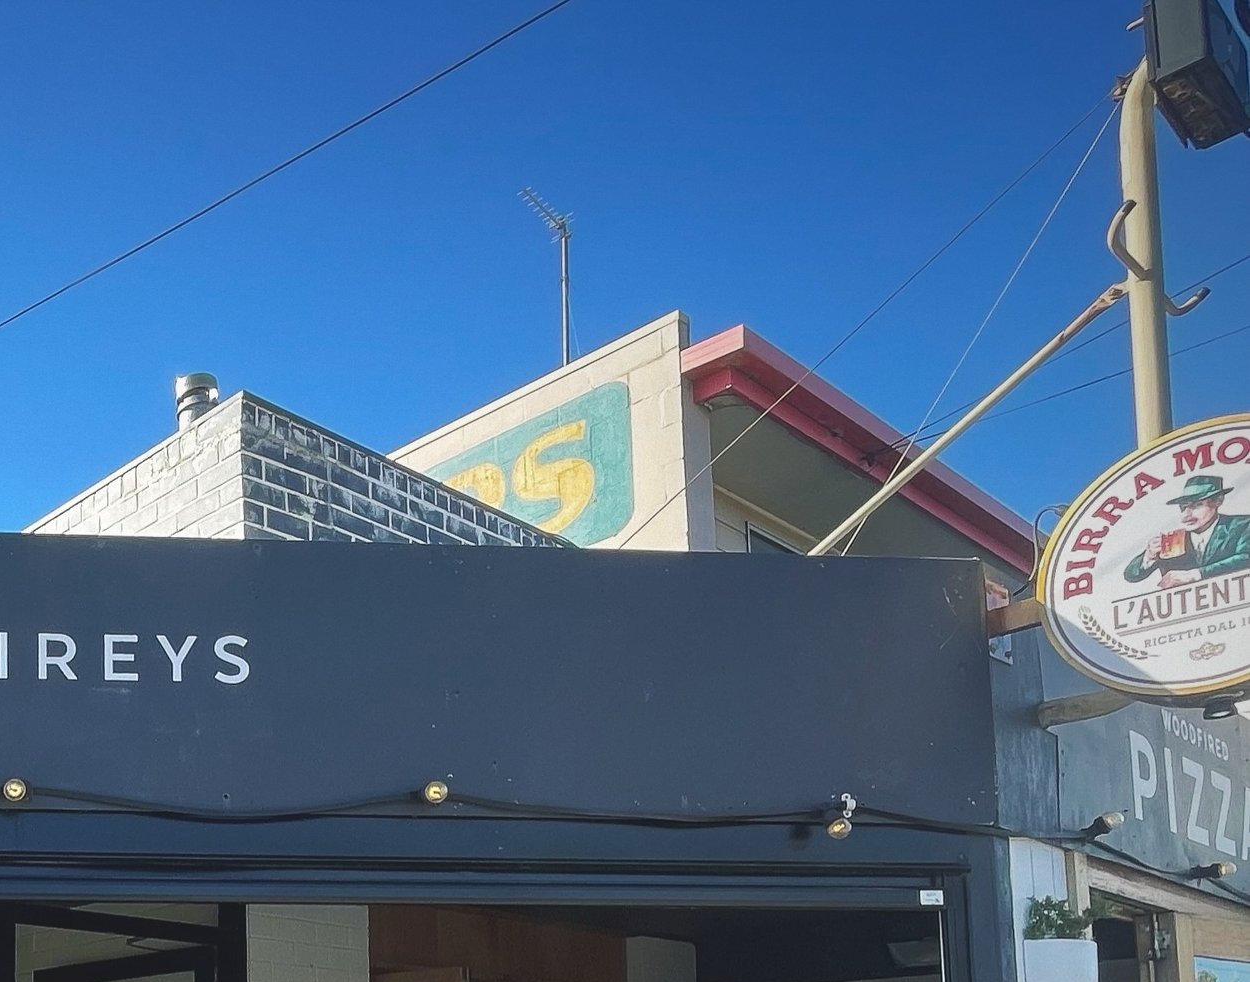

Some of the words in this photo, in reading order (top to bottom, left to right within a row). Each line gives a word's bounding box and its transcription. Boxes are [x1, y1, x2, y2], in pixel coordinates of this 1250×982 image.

[1064, 471, 1165, 600] BIRRA
[1172, 437, 1250, 478] MO
[1144, 627, 1203, 648] RICETTA
[1207, 621, 1236, 635] DAL
[1160, 708, 1229, 761] WOODFIRED
[1129, 730, 1250, 861] PIZZ
